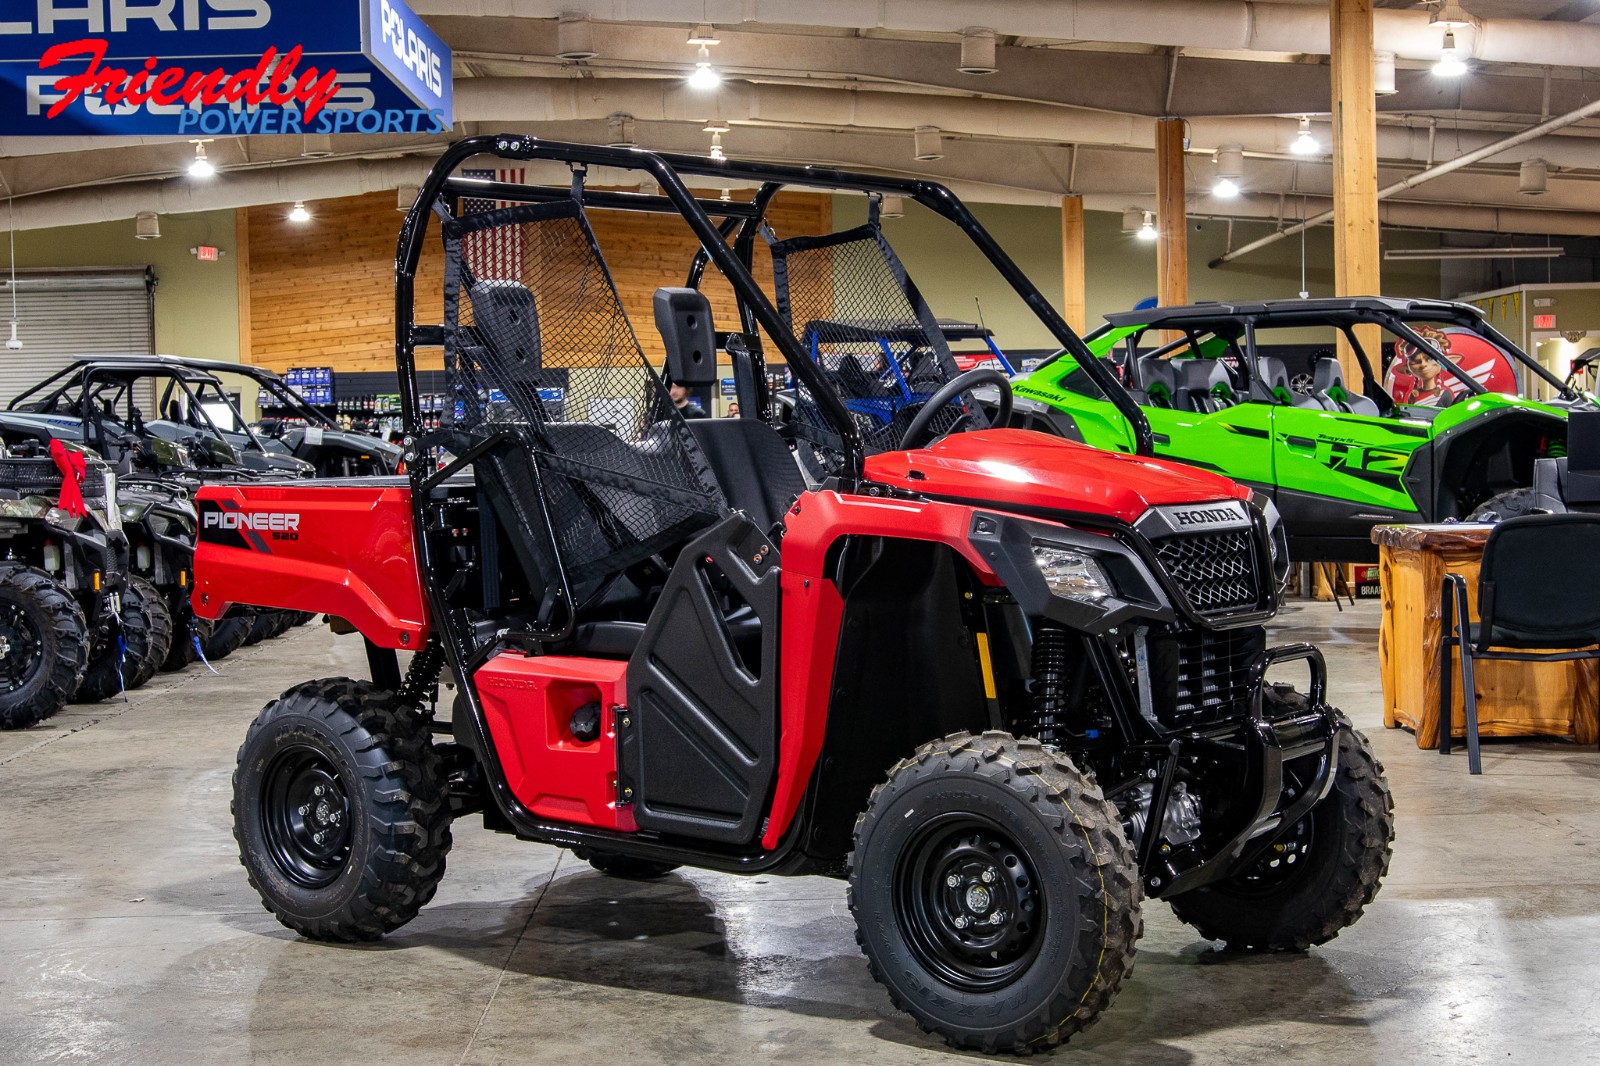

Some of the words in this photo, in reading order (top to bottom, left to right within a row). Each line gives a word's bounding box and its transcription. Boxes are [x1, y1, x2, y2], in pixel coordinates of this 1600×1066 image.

[380, 0, 442, 98] POLARIS
[1012, 384, 1067, 402] Kawasaki
[203, 511, 300, 531] PIONEER
[1172, 507, 1244, 525] HONDA
[271, 532, 299, 541] 520
